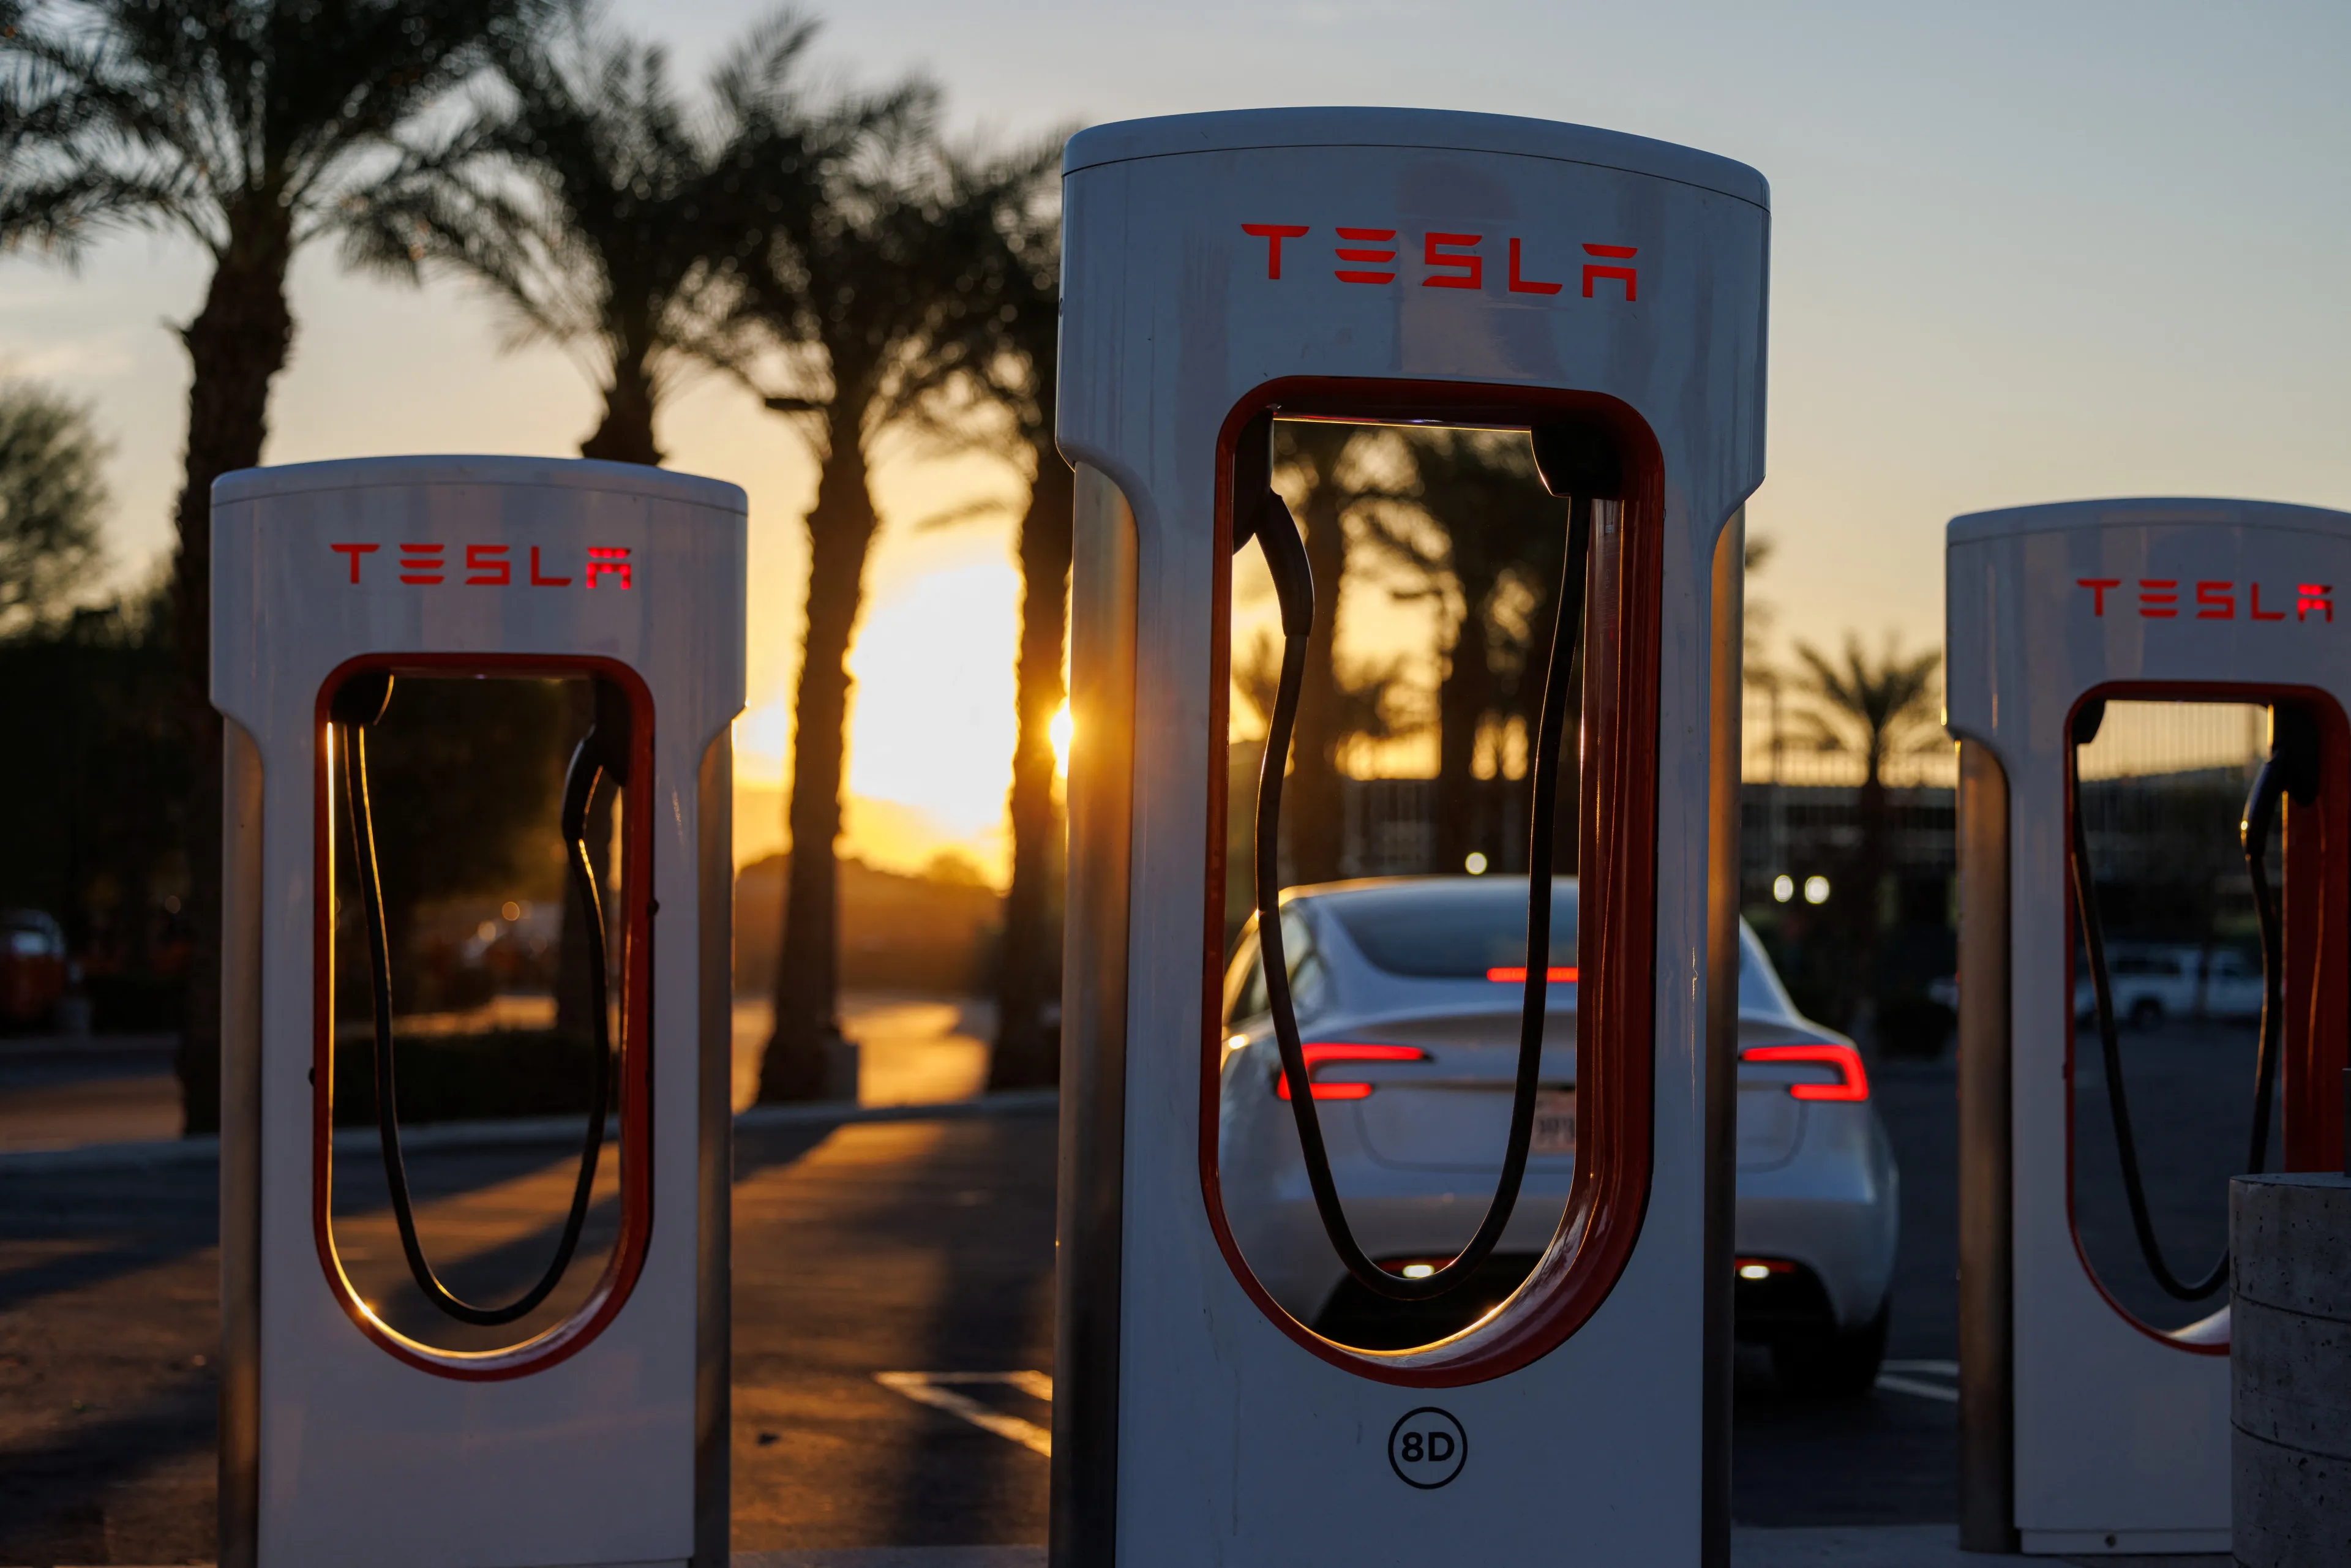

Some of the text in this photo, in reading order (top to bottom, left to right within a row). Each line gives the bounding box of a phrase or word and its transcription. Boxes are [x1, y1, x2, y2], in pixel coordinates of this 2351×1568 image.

[1241, 223, 1638, 301] TESLA
[330, 543, 632, 590] TESLA
[2077, 579, 2333, 623] TESLA
[1401, 1431, 1455, 1462] 8D
